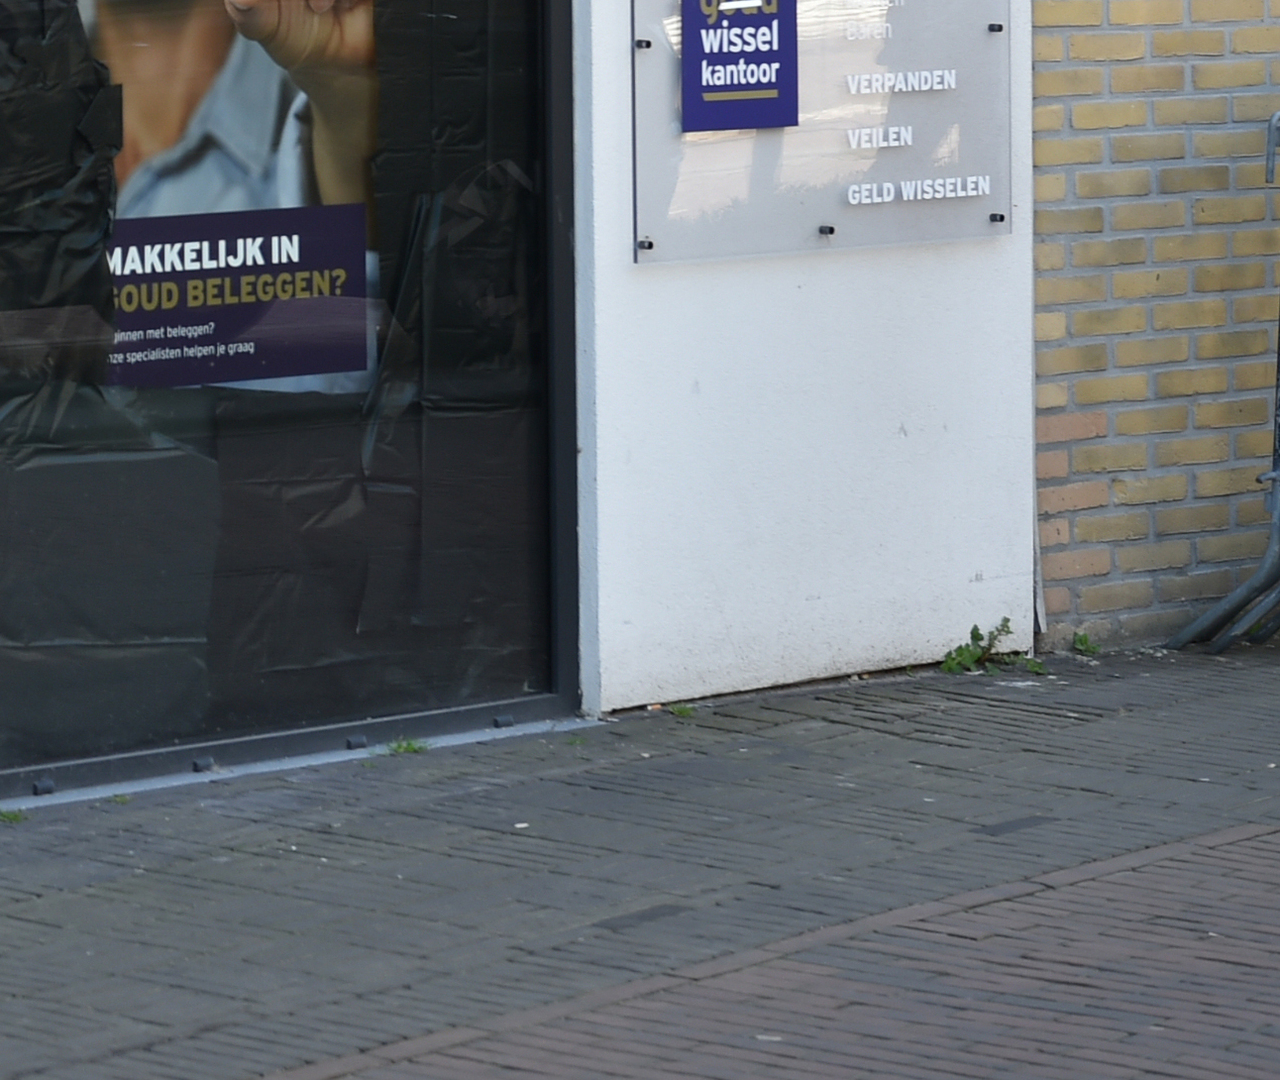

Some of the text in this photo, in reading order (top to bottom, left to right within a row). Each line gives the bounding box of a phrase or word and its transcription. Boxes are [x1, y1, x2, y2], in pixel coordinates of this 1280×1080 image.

[700, 19, 779, 53] wissel
[701, 58, 780, 86] kantoor
[847, 69, 956, 94] VERPANDEN
[848, 126, 913, 149] VEILEN
[848, 175, 990, 205] GELD WISSELEN
[271, 235, 300, 264] IN
[187, 268, 346, 308] BELEGGEN?
[146, 328, 165, 339] met
[167, 322, 215, 340] beleggen?
[126, 346, 181, 364] specialisten
[183, 343, 215, 358] helpen
[217, 342, 226, 356] je
[227, 341, 255, 356] graag
